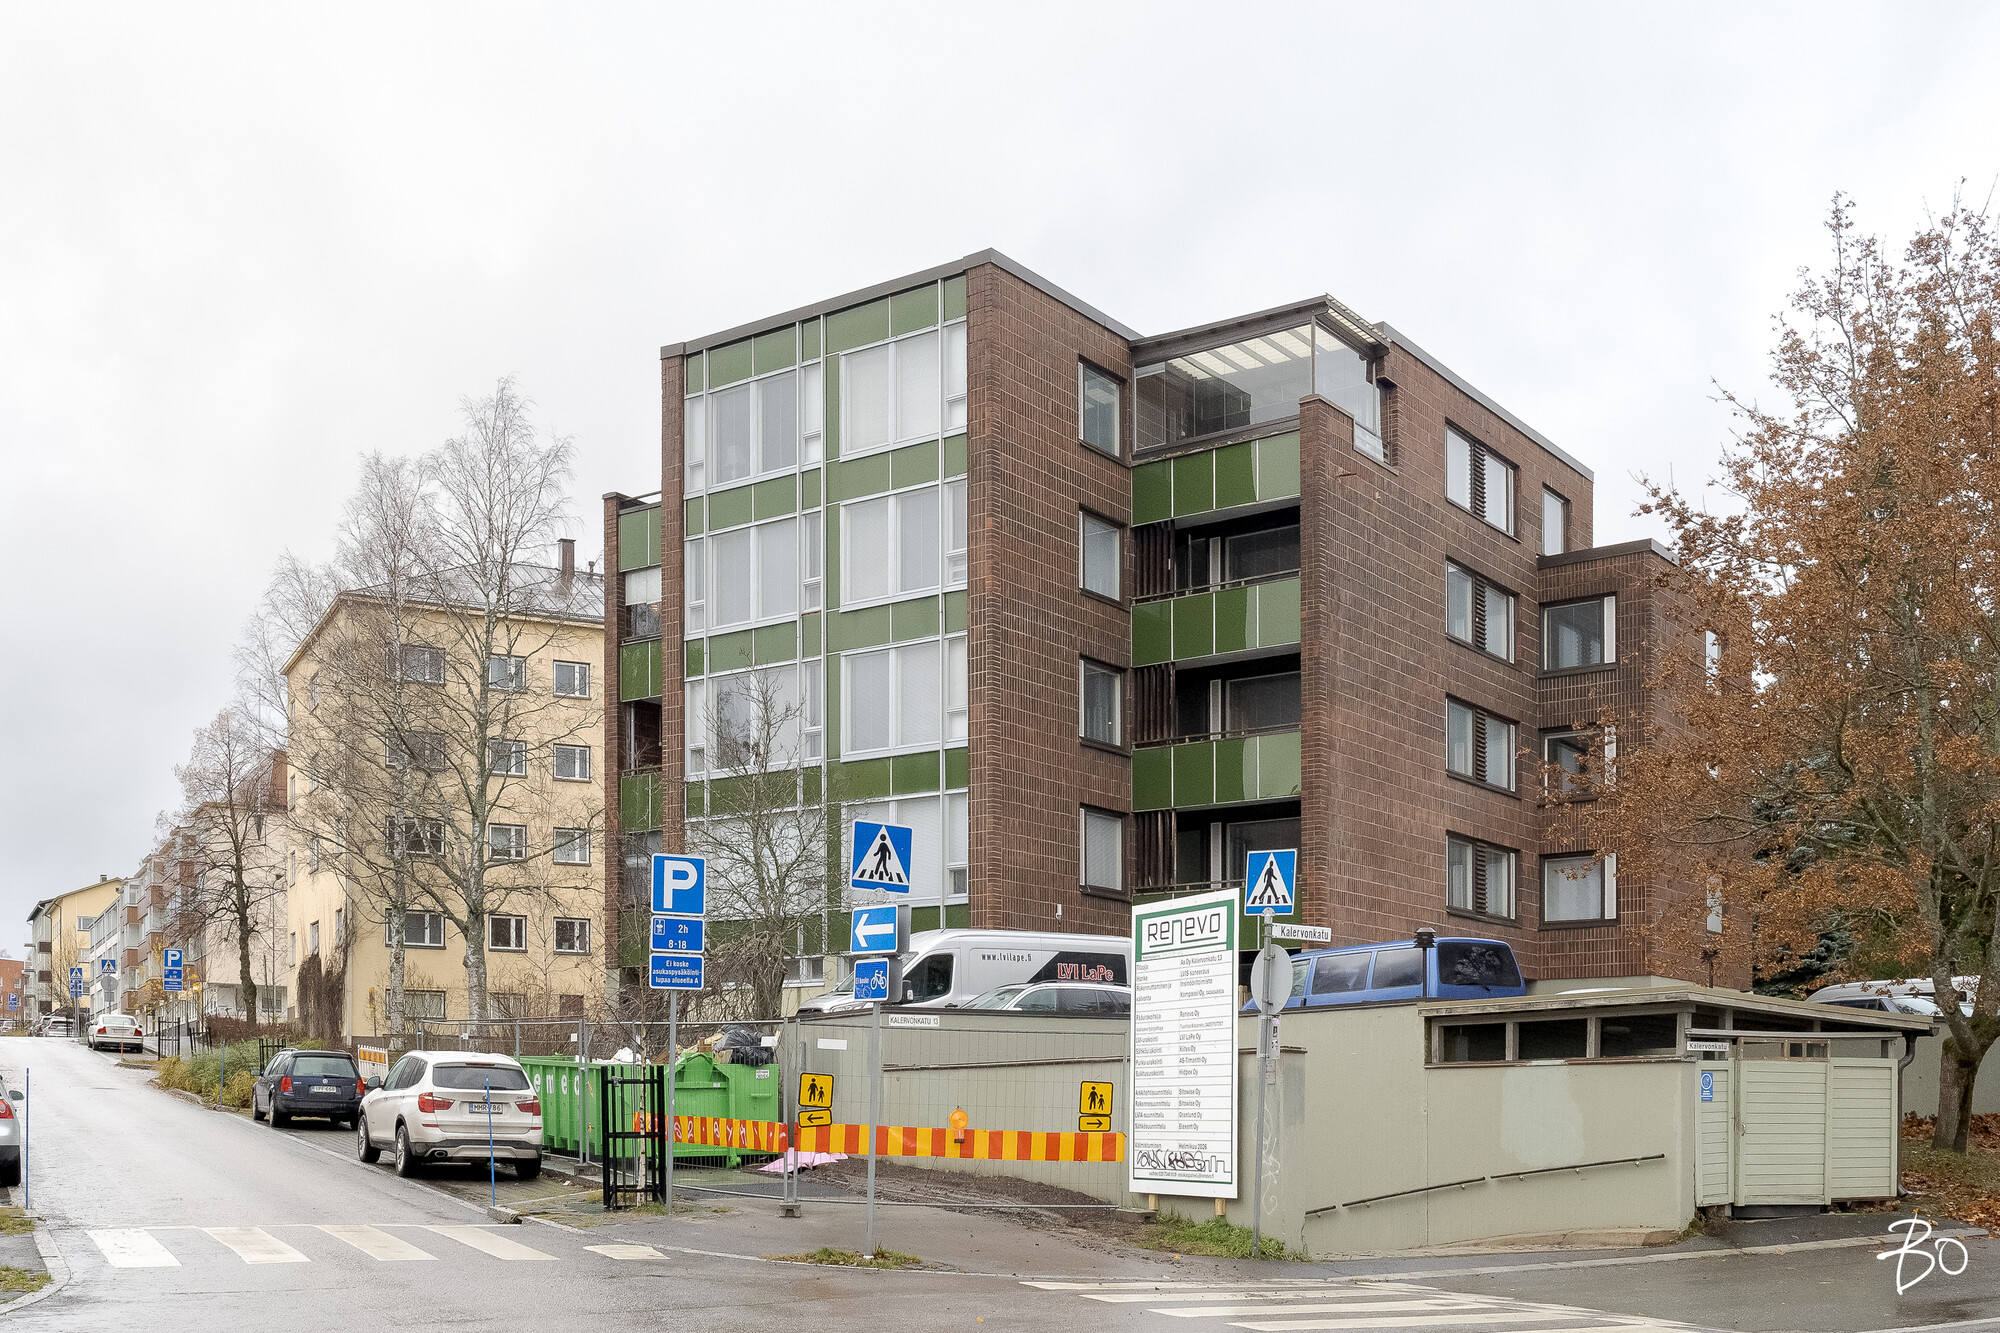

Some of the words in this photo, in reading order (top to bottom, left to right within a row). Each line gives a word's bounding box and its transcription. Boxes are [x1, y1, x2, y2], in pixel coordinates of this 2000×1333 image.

[663, 859, 698, 909] P
[678, 924, 689, 934] 2h
[1280, 926, 1329, 940] Kalervonkatu
[668, 939, 687, 949] 8-18
[168, 950, 181, 967] P
[982, 952, 1032, 962] www.lvilape.fi
[1057, 963, 1079, 979] LVI
[1081, 964, 1114, 981] LaPe
[890, 1016, 932, 1025] KALERVONKATU
[1689, 1043, 1728, 1051] Kalervonkatu
